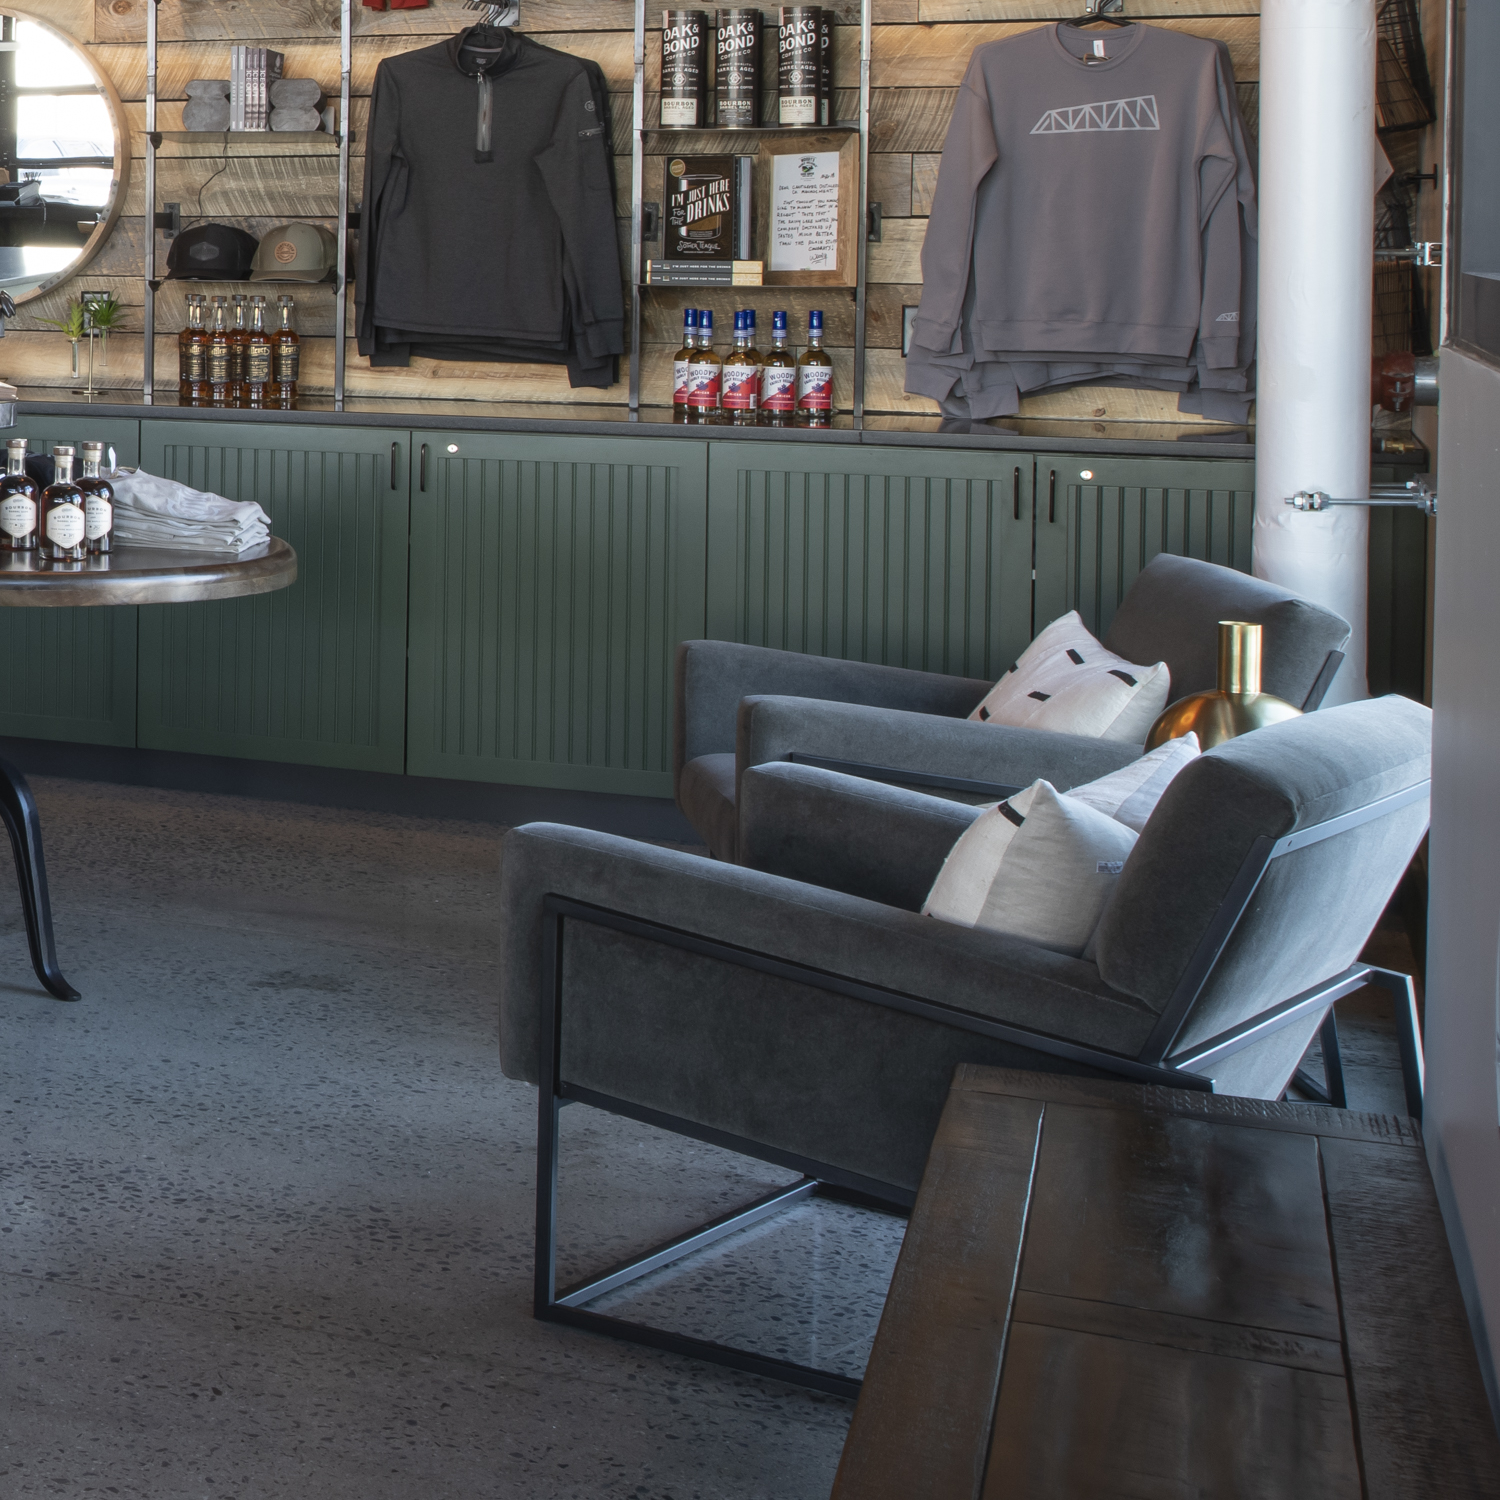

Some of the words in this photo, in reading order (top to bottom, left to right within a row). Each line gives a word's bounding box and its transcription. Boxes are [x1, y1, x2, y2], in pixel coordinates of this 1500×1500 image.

[663, 35, 700, 55] BOND
[717, 34, 755, 55] BOND
[779, 32, 816, 53] BOND
[671, 193, 684, 207] I'M
[686, 185, 707, 204] JUST
[709, 178, 730, 195] HERE
[686, 193, 730, 224] DRINKS
[670, 216, 684, 226] THE
[690, 369, 717, 377] WOODY'S
